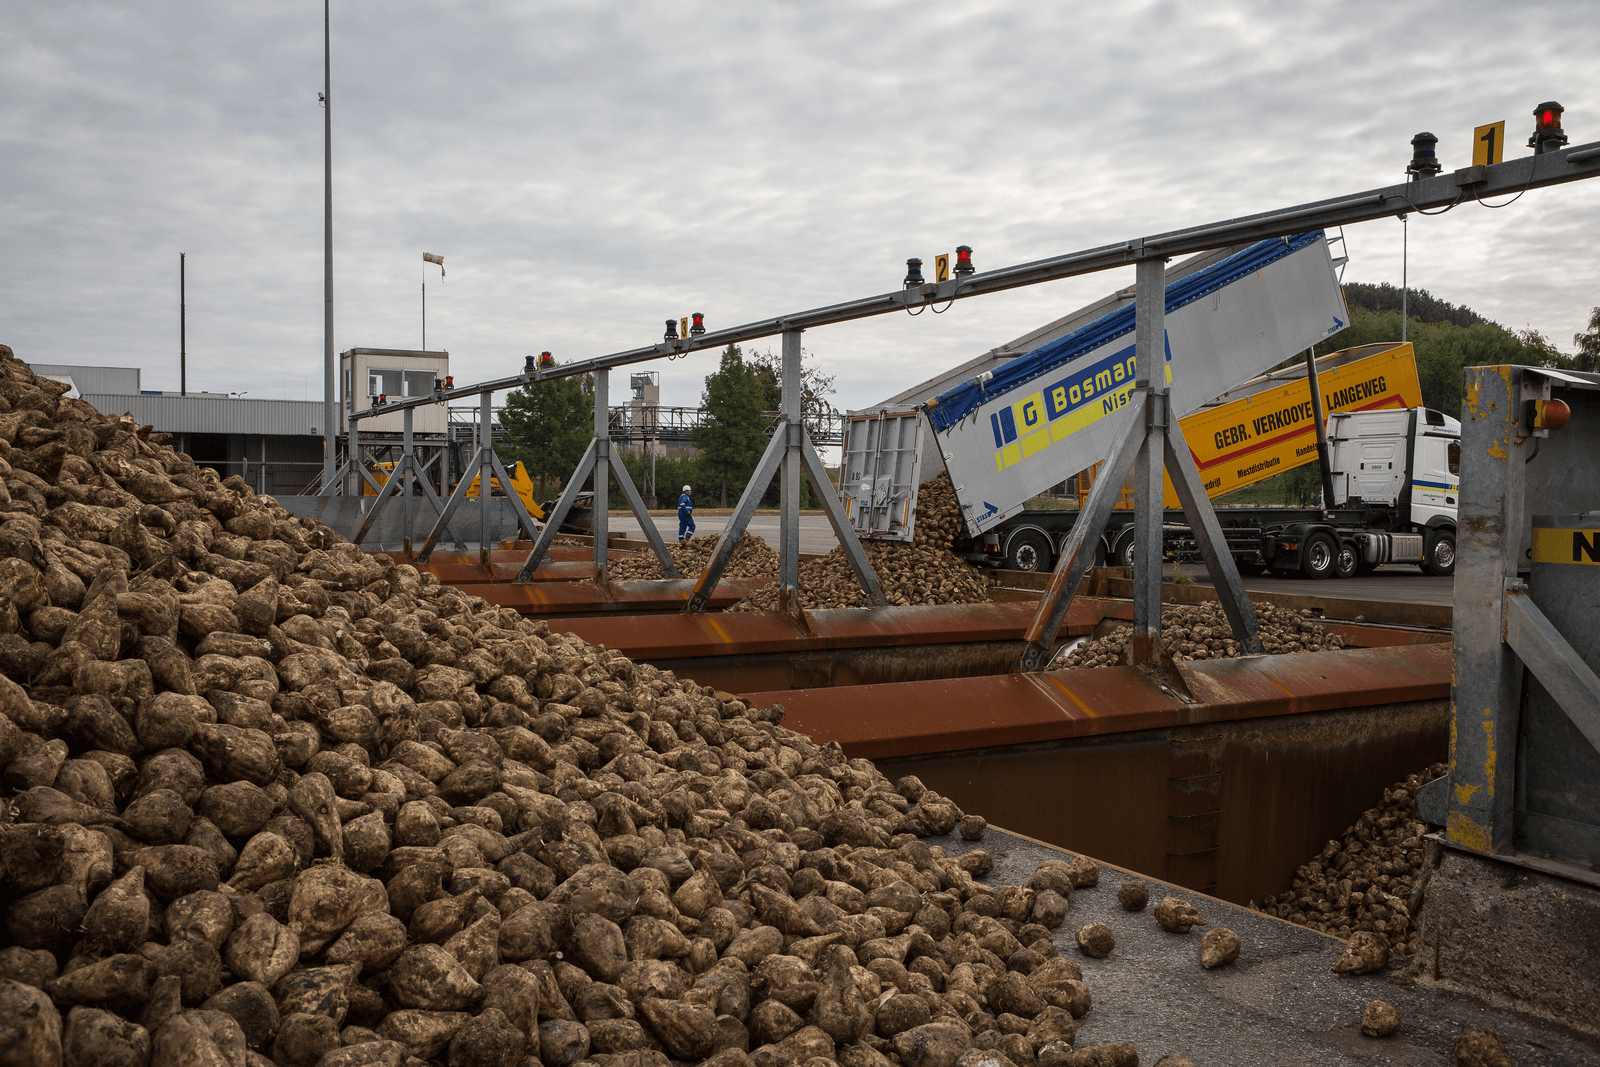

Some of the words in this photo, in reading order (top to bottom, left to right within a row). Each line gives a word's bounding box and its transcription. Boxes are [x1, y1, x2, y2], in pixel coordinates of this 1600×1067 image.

[1481, 127, 1495, 165] 1
[938, 257, 947, 282] 2
[682, 321, 687, 337] 3
[1022, 400, 1038, 427] G
[1214, 423, 1252, 450] GEBR.
[1252, 400, 1315, 436] VERKOOYE
[1326, 376, 1387, 411] LANGEWEG
[1203, 477, 1221, 490] edrijf
[1237, 456, 1281, 479] Mestdistributie
[1573, 532, 1600, 563] N
